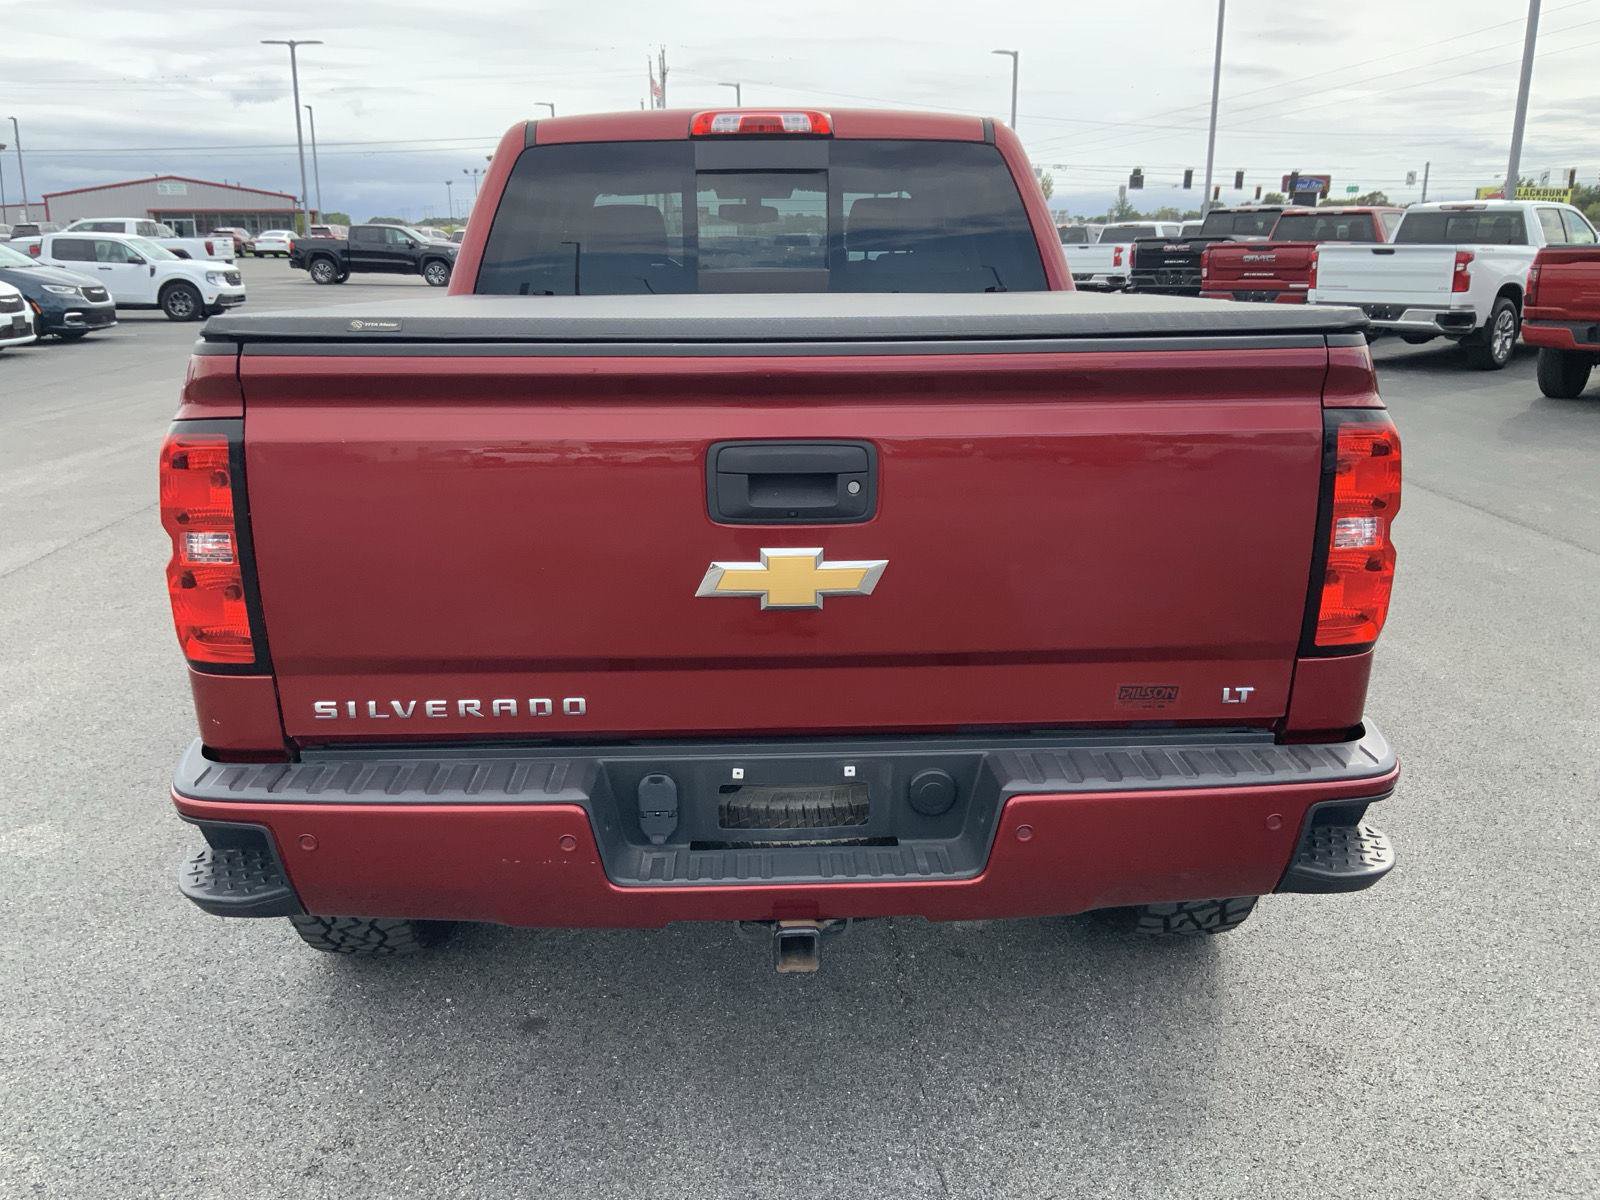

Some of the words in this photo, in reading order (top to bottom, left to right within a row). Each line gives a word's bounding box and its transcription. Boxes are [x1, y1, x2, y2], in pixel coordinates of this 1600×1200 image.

[1514, 188, 1569, 197] LACKBURN
[1243, 254, 1276, 262] GMC
[1221, 686, 1255, 703] LT
[313, 696, 588, 720] SILVERADO
